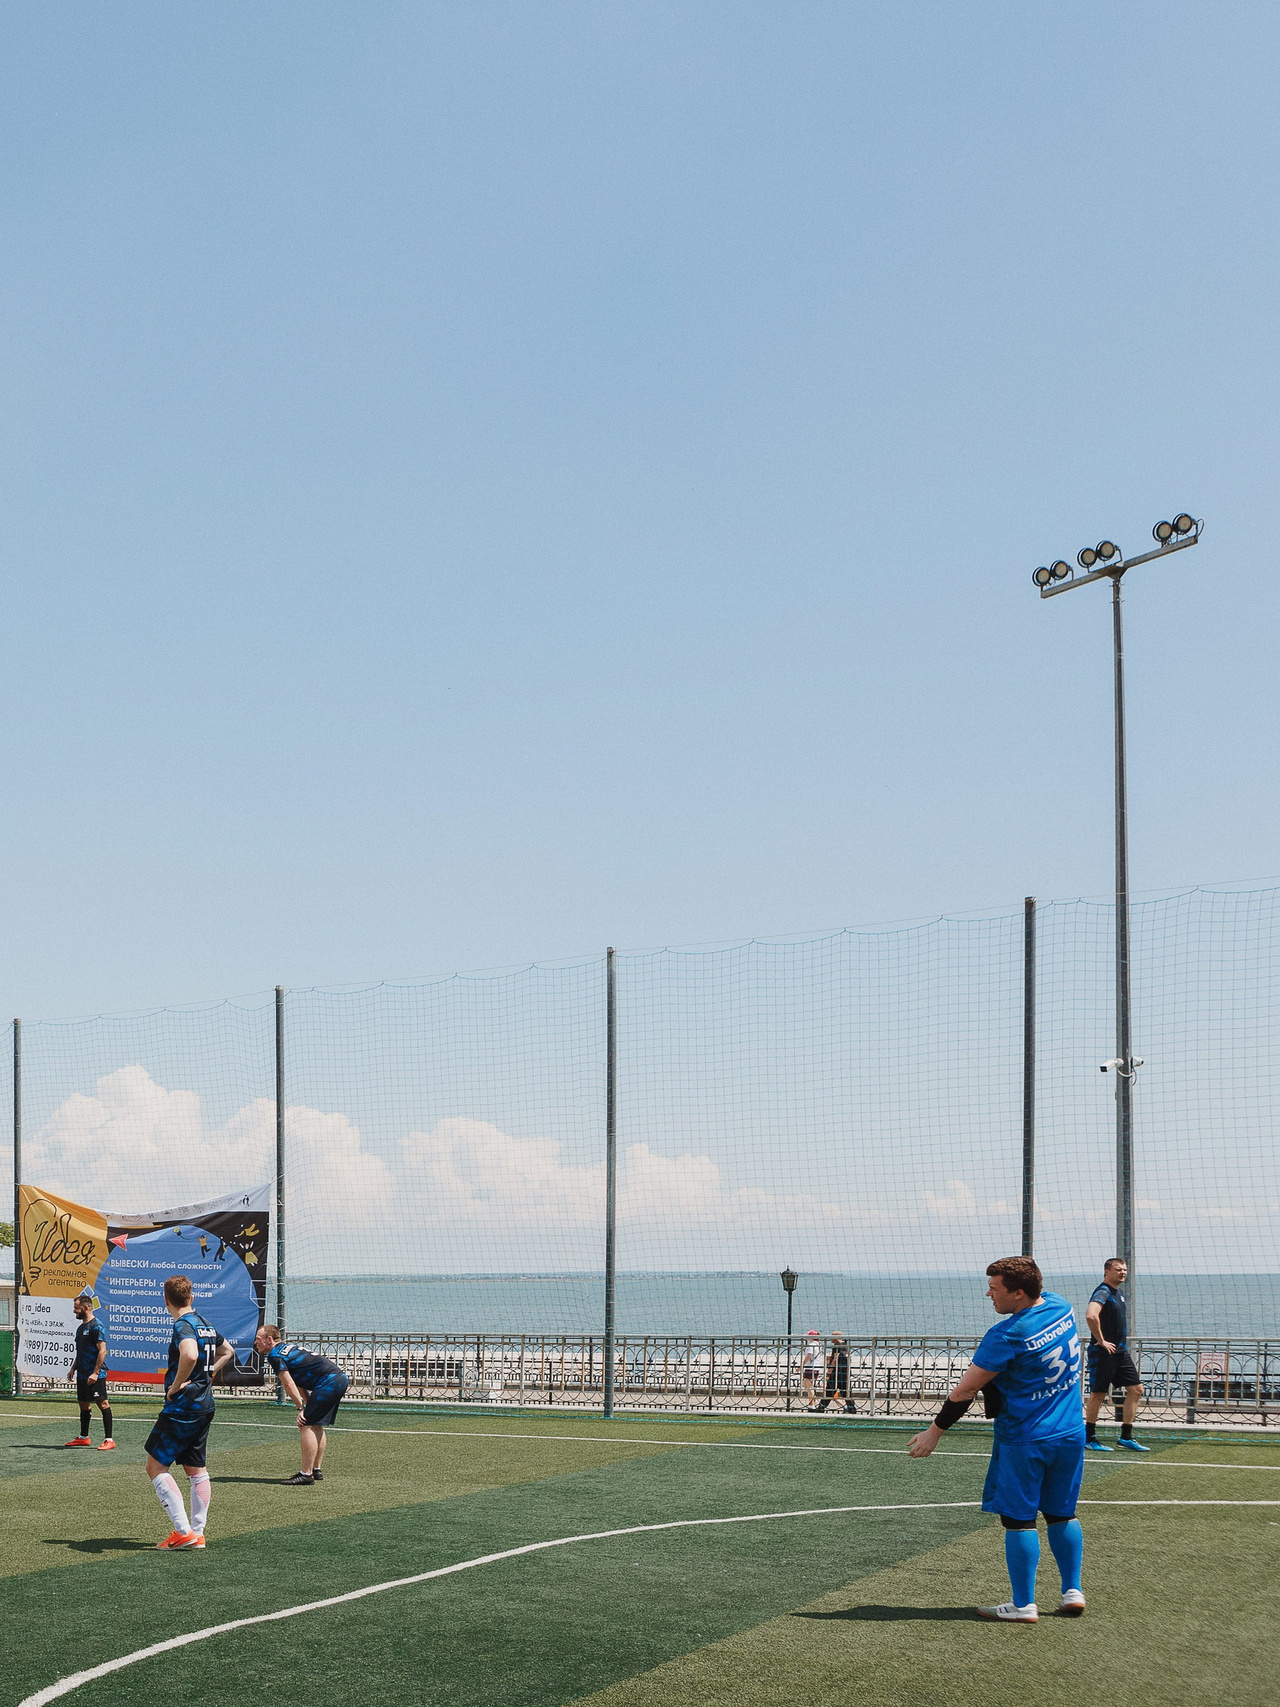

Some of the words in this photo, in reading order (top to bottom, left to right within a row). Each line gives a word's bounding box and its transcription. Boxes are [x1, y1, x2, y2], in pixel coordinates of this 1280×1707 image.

[110, 1259, 149, 1269] ВЫВЕСКИ
[150, 1261, 176, 1269] любой
[177, 1262, 222, 1270] сложности
[43, 1268, 87, 1279] рекламное
[48, 1278, 87, 1288] агентство
[109, 1277, 156, 1288] ИНТЕРЬЕРЫ
[109, 1288, 161, 1298] коммерческих
[25, 1302, 51, 1315] ra_idea
[109, 1304, 171, 1316] ПРОЕКТИРОВА
[49, 1320, 65, 1328] ЭТАЖ
[109, 1314, 174, 1325] ИЗГОТОВЛЕНИЕ
[133, 1326, 174, 1336] архитектур
[1025, 1318, 1073, 1351] Umbrella
[109, 1333, 144, 1341] торгового
[144, 1334, 172, 1344] оборуд
[109, 1349, 161, 1360] РЕКЛАМНАЯ
[1041, 1333, 1081, 1384] 35
